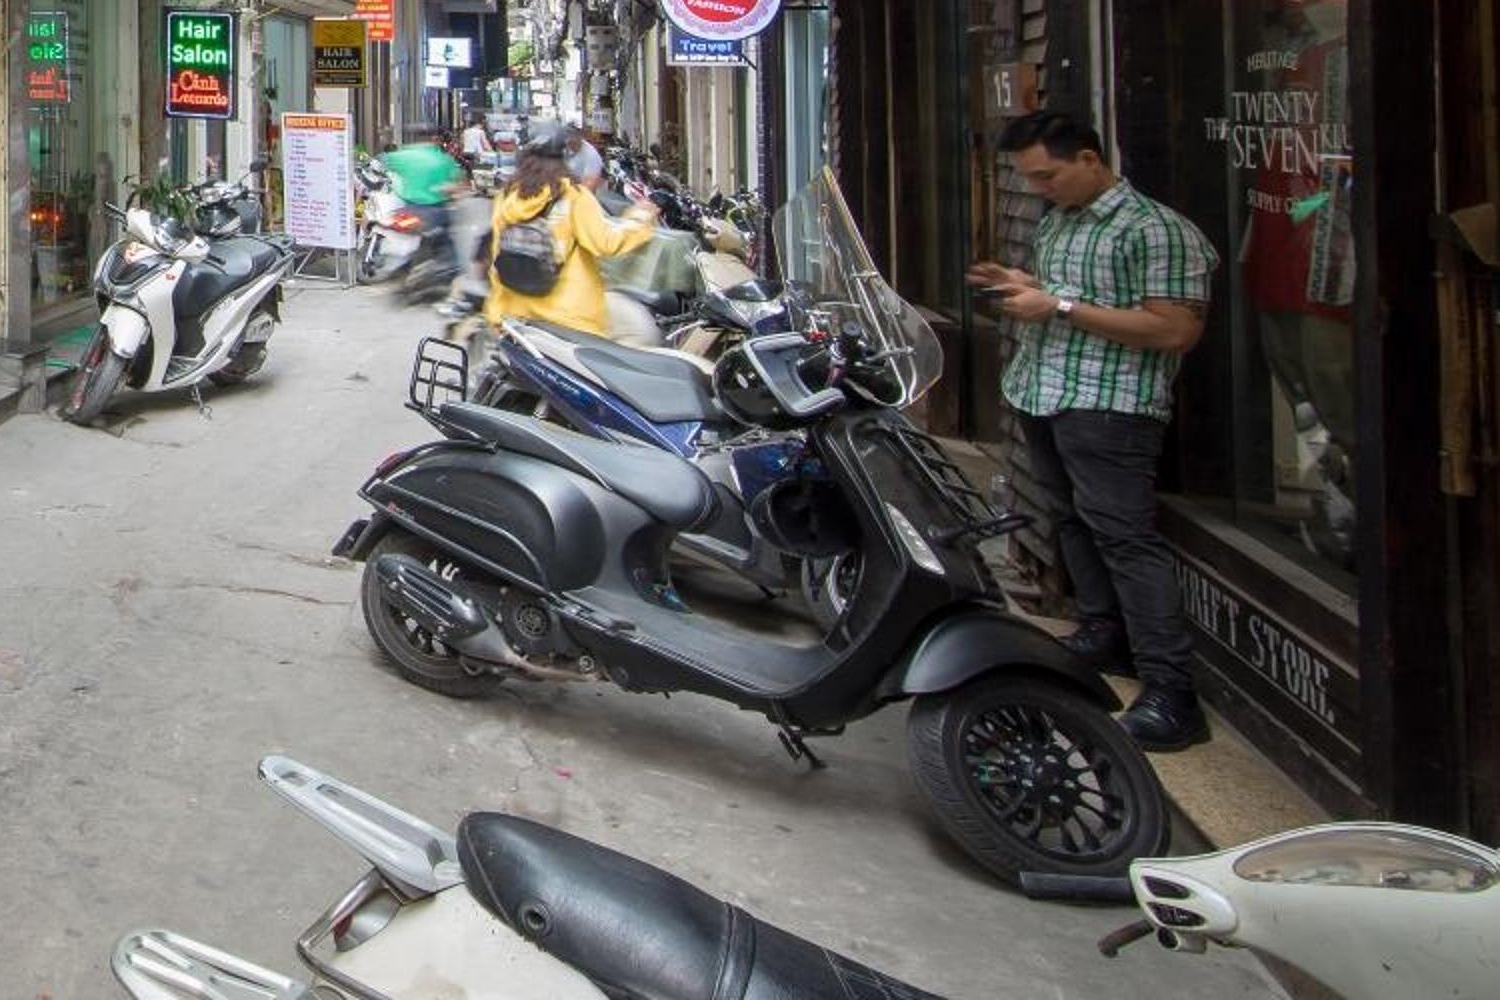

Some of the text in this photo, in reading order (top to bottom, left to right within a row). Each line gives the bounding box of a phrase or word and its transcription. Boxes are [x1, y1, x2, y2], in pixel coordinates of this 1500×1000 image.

[179, 20, 221, 39] Hair
[172, 44, 228, 65] Salon
[680, 39, 732, 53] Travel
[317, 58, 359, 69] SALON
[994, 71, 1011, 107] 15
[1231, 91, 1320, 124] TWENTY
[1232, 124, 1319, 175] SEVEN
[1249, 614, 1335, 725] STORE
